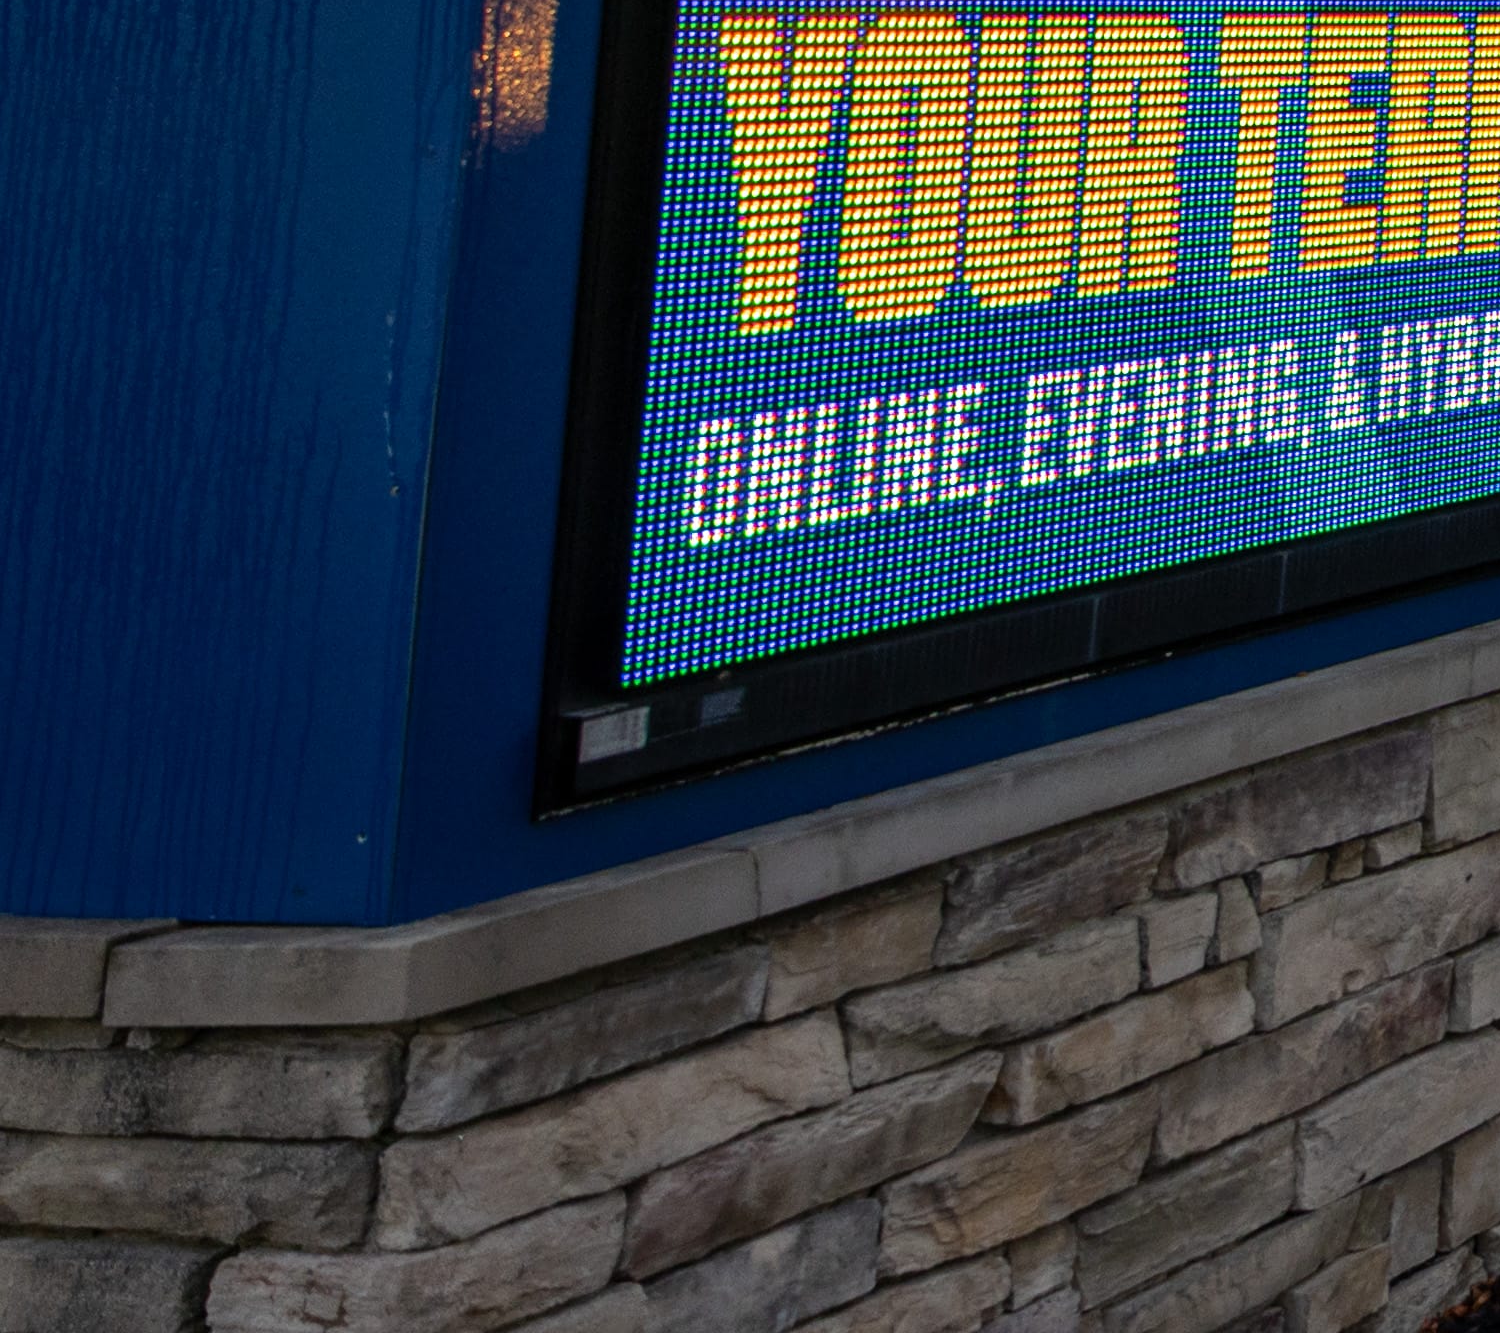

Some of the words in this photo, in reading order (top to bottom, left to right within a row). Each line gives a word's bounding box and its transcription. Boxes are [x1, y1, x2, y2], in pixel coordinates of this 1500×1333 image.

[719, 9, 1190, 336] YOUR
[687, 380, 1003, 546] ONLINE,
[1021, 337, 1315, 488] EVENING,
[1324, 328, 1367, 431] &
